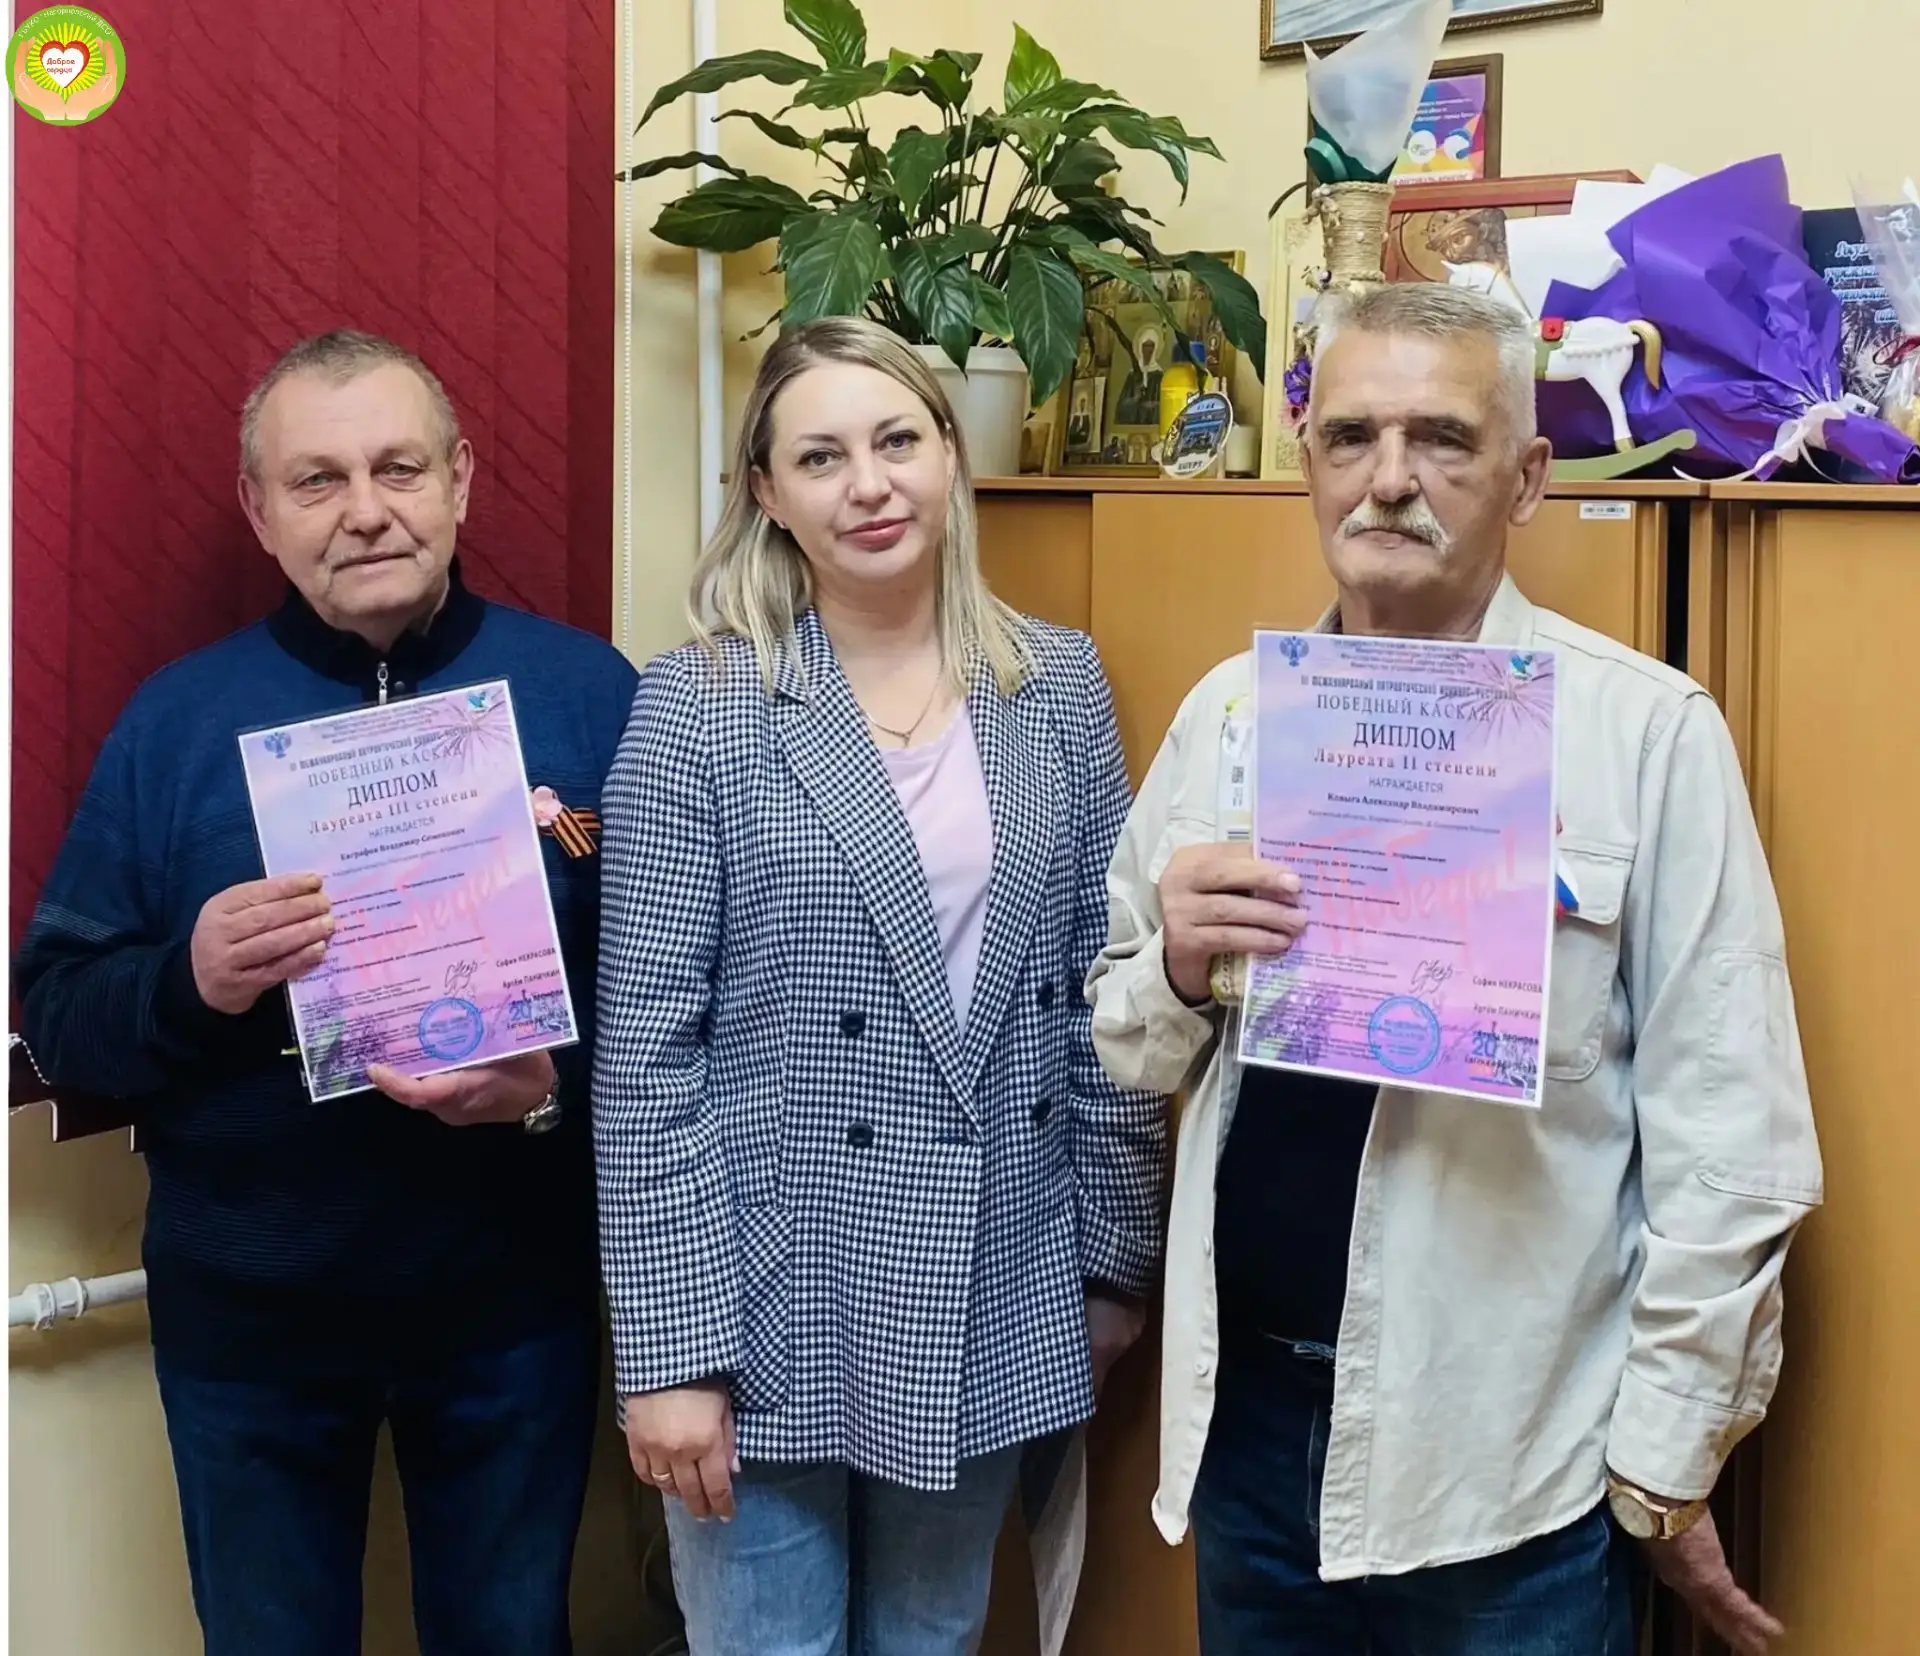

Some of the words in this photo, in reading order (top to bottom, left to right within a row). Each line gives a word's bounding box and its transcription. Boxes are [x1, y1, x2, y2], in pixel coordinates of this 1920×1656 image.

[1317, 694, 1412, 716] ПОБЕДНЫЙ
[1420, 701, 1491, 722] КАСКАД
[1353, 722, 1456, 751] ДИПЛОМ
[308, 756, 394, 788] ПОБЕДНЫЙ
[1314, 749, 1395, 769] Лауреата
[1403, 756, 1418, 771] II
[1424, 761, 1498, 778] степени
[348, 769, 438, 810] ДИПЛОМ
[1368, 777, 1445, 793] НАГРАЖДАЕТСЯ
[309, 811, 383, 835] Лауреата
[415, 789, 478, 810] степени
[1362, 796, 1410, 810] Александр
[1411, 801, 1479, 815] Владимирович
[368, 816, 436, 838] НАГРАЖДАЕТСЯ
[380, 837, 420, 853] Владимир
